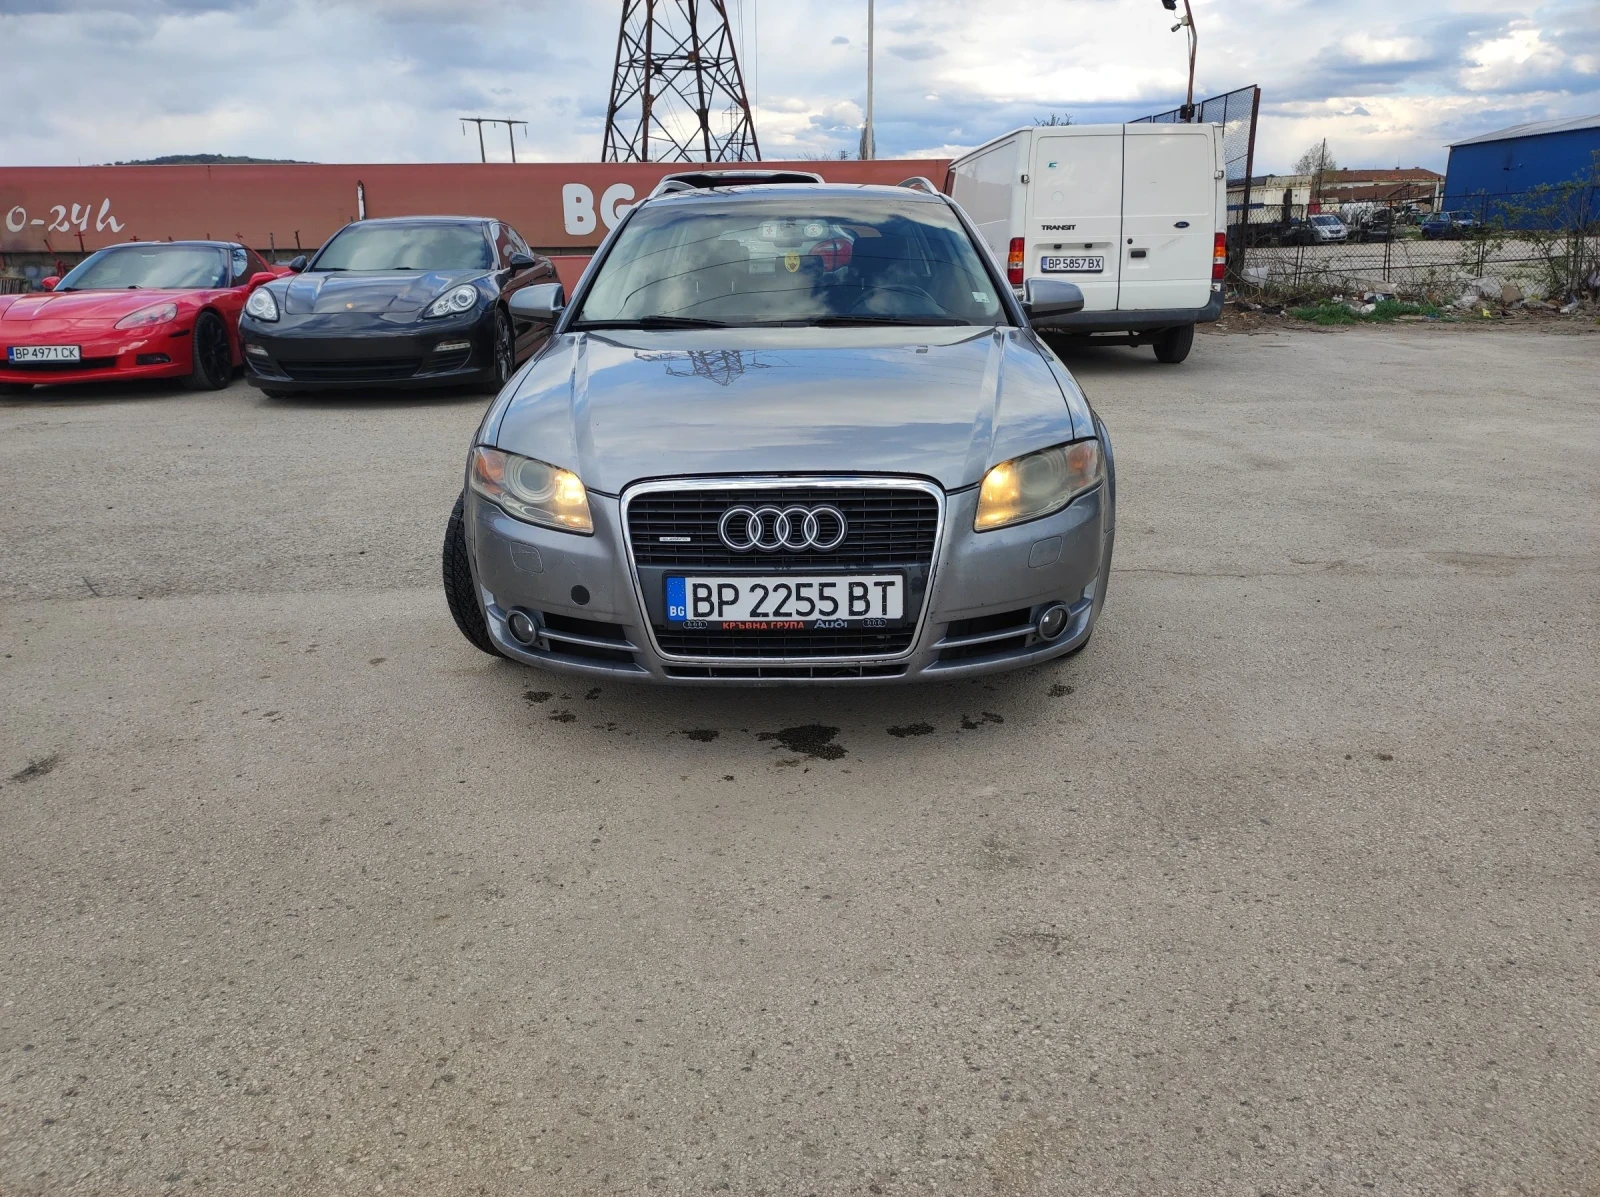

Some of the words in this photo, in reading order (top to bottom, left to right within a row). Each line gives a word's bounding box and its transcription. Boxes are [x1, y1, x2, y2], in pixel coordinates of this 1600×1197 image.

[5, 197, 125, 233] 0-24h
[1048, 258, 1061, 268] BP
[1062, 258, 1087, 269] 5857
[1088, 258, 1101, 269] BX
[15, 348, 29, 360] BP
[31, 347, 58, 359] 4971
[61, 347, 77, 358] CK
[692, 582, 740, 618] BP
[749, 582, 839, 618] 2255
[848, 580, 896, 617] BT
[669, 605, 685, 617] BG
[722, 621, 768, 630] КРЪВНА
[770, 620, 805, 629] ГРУПА
[814, 618, 848, 629] Audi
